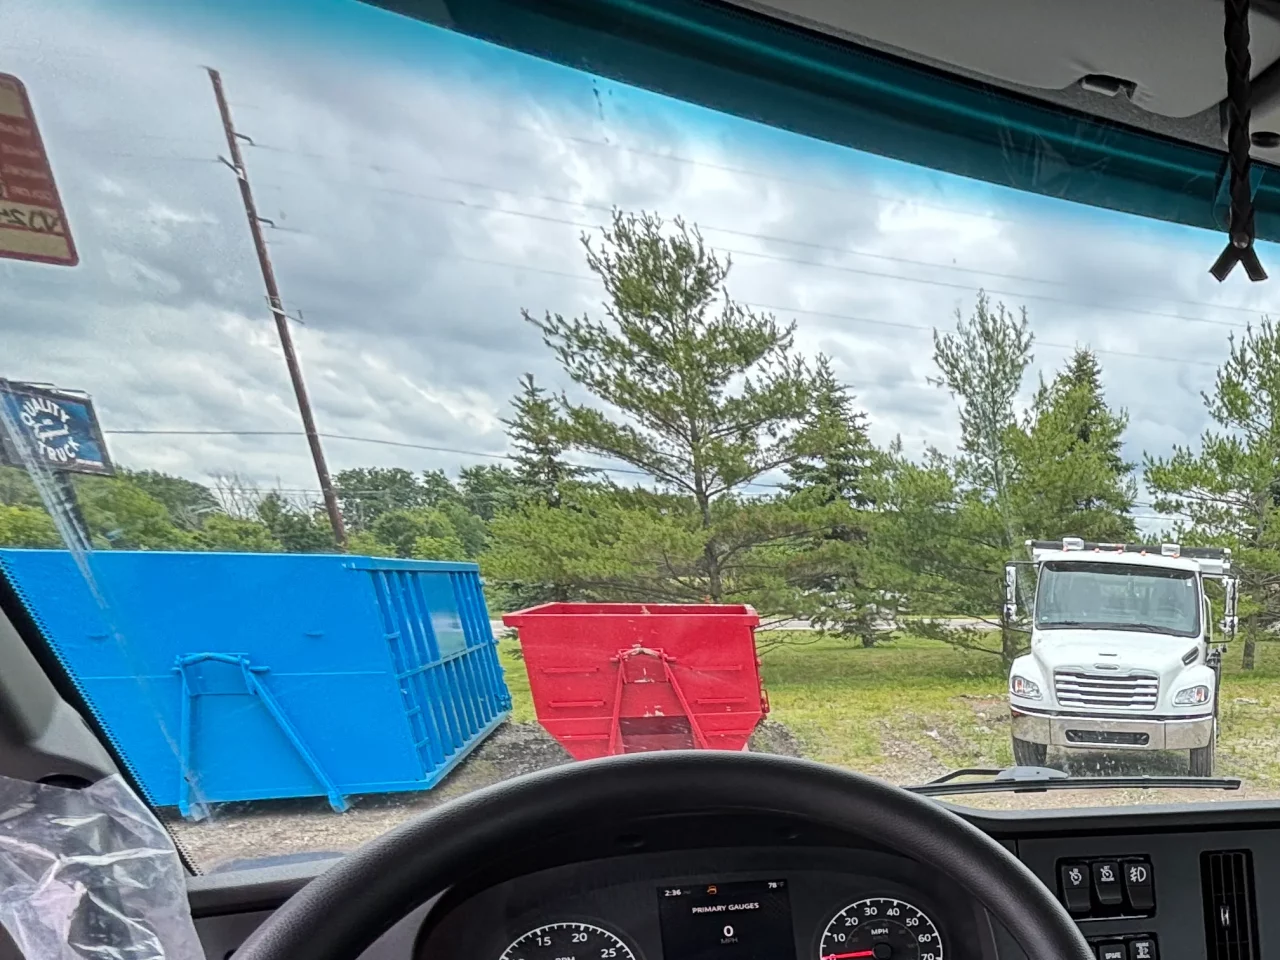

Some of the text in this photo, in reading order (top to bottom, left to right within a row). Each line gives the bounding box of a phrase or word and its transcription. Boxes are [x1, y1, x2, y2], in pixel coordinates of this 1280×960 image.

[20, 398, 71, 427] QUALITY
[37, 436, 80, 462] TRUCK
[664, 889, 682, 897] 2:36
[692, 902, 760, 914] PRIMARY GAUGES
[864, 907, 878, 916] 30
[886, 907, 900, 917] 40
[844, 917, 859, 926] 20
[906, 917, 919, 927] 50
[723, 925, 734, 937] 0
[536, 936, 552, 946] 15
[571, 932, 588, 943] 20
[832, 933, 846, 942] 10
[918, 933, 931, 943] 60
[600, 948, 617, 958] 25
